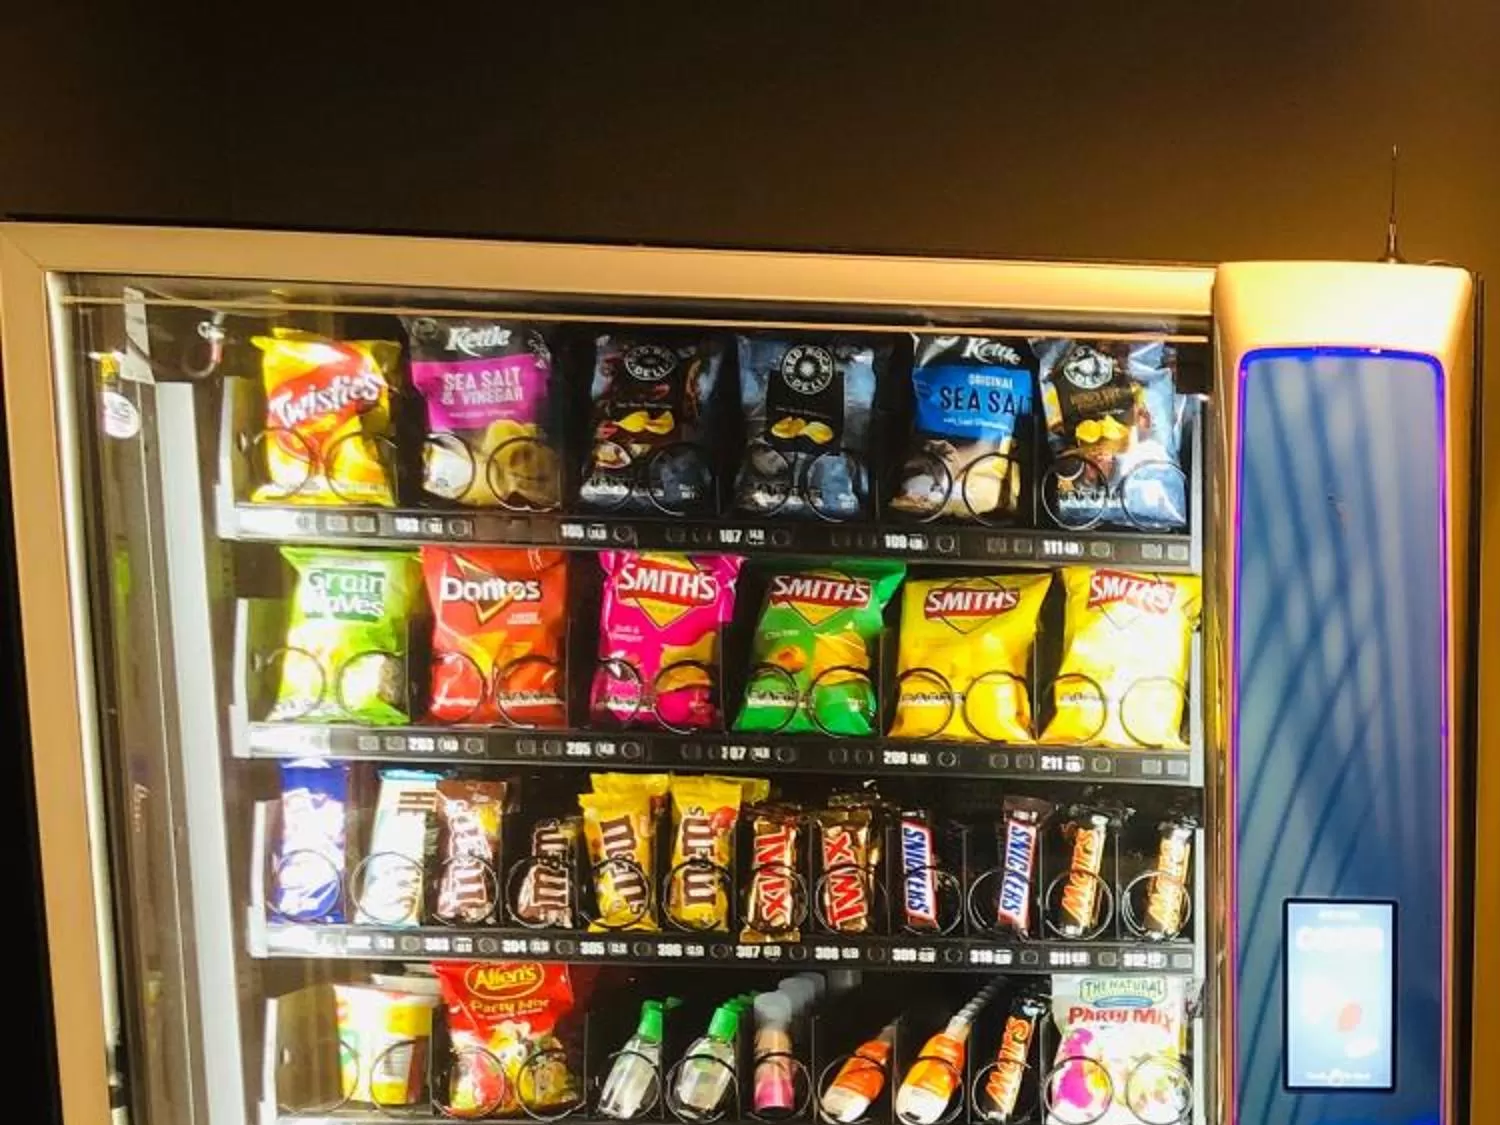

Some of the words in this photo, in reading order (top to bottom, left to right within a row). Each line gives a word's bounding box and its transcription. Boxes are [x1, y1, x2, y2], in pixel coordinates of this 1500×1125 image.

[443, 371, 476, 392] SEA
[479, 366, 521, 390] SALT
[268, 366, 388, 428] Twisties
[940, 386, 980, 411] SEA
[441, 576, 541, 602] Doritos
[618, 563, 717, 600] SMITH'S
[771, 575, 870, 603] SMITH'S
[925, 590, 1019, 613] SMITH'S
[822, 831, 868, 928] TWIX
[1001, 825, 1033, 916] SNICKERS
